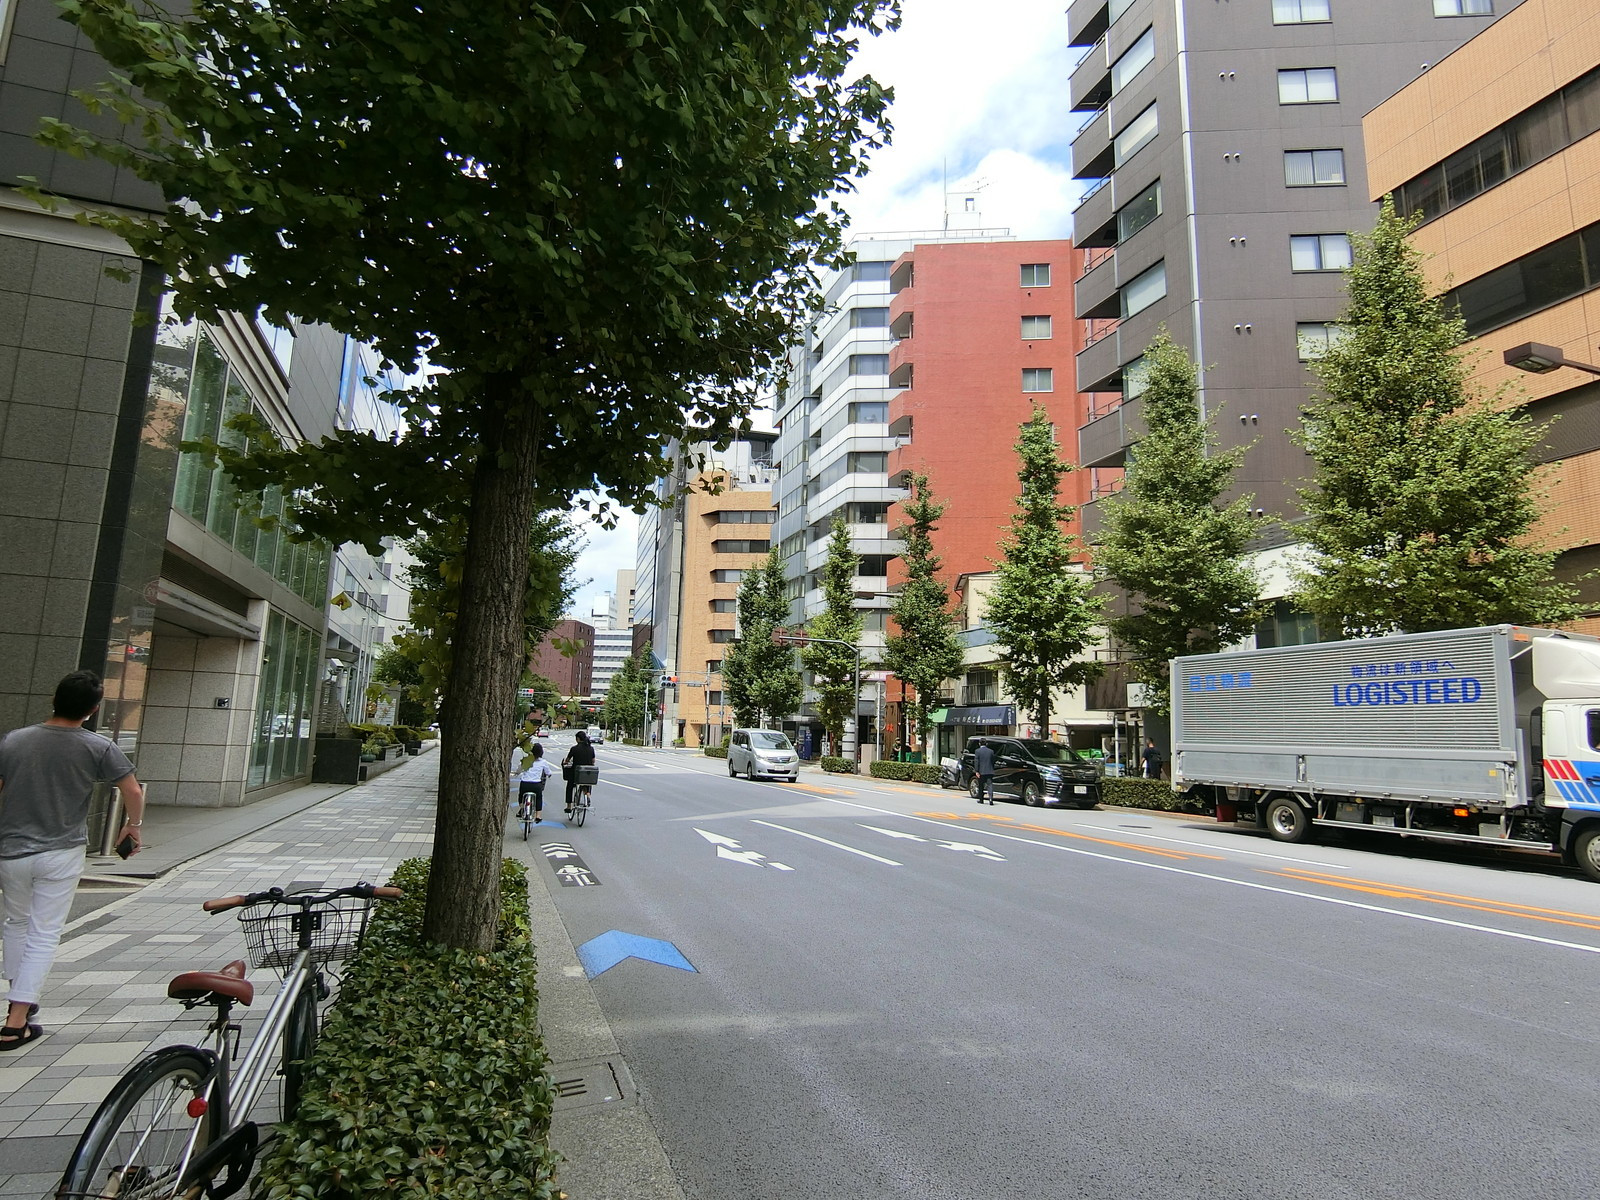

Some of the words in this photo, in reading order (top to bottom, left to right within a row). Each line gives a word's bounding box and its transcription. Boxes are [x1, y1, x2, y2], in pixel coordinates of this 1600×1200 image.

[1189, 672, 1252, 691] 日立物流
[1333, 677, 1481, 706] LOGISTEED
